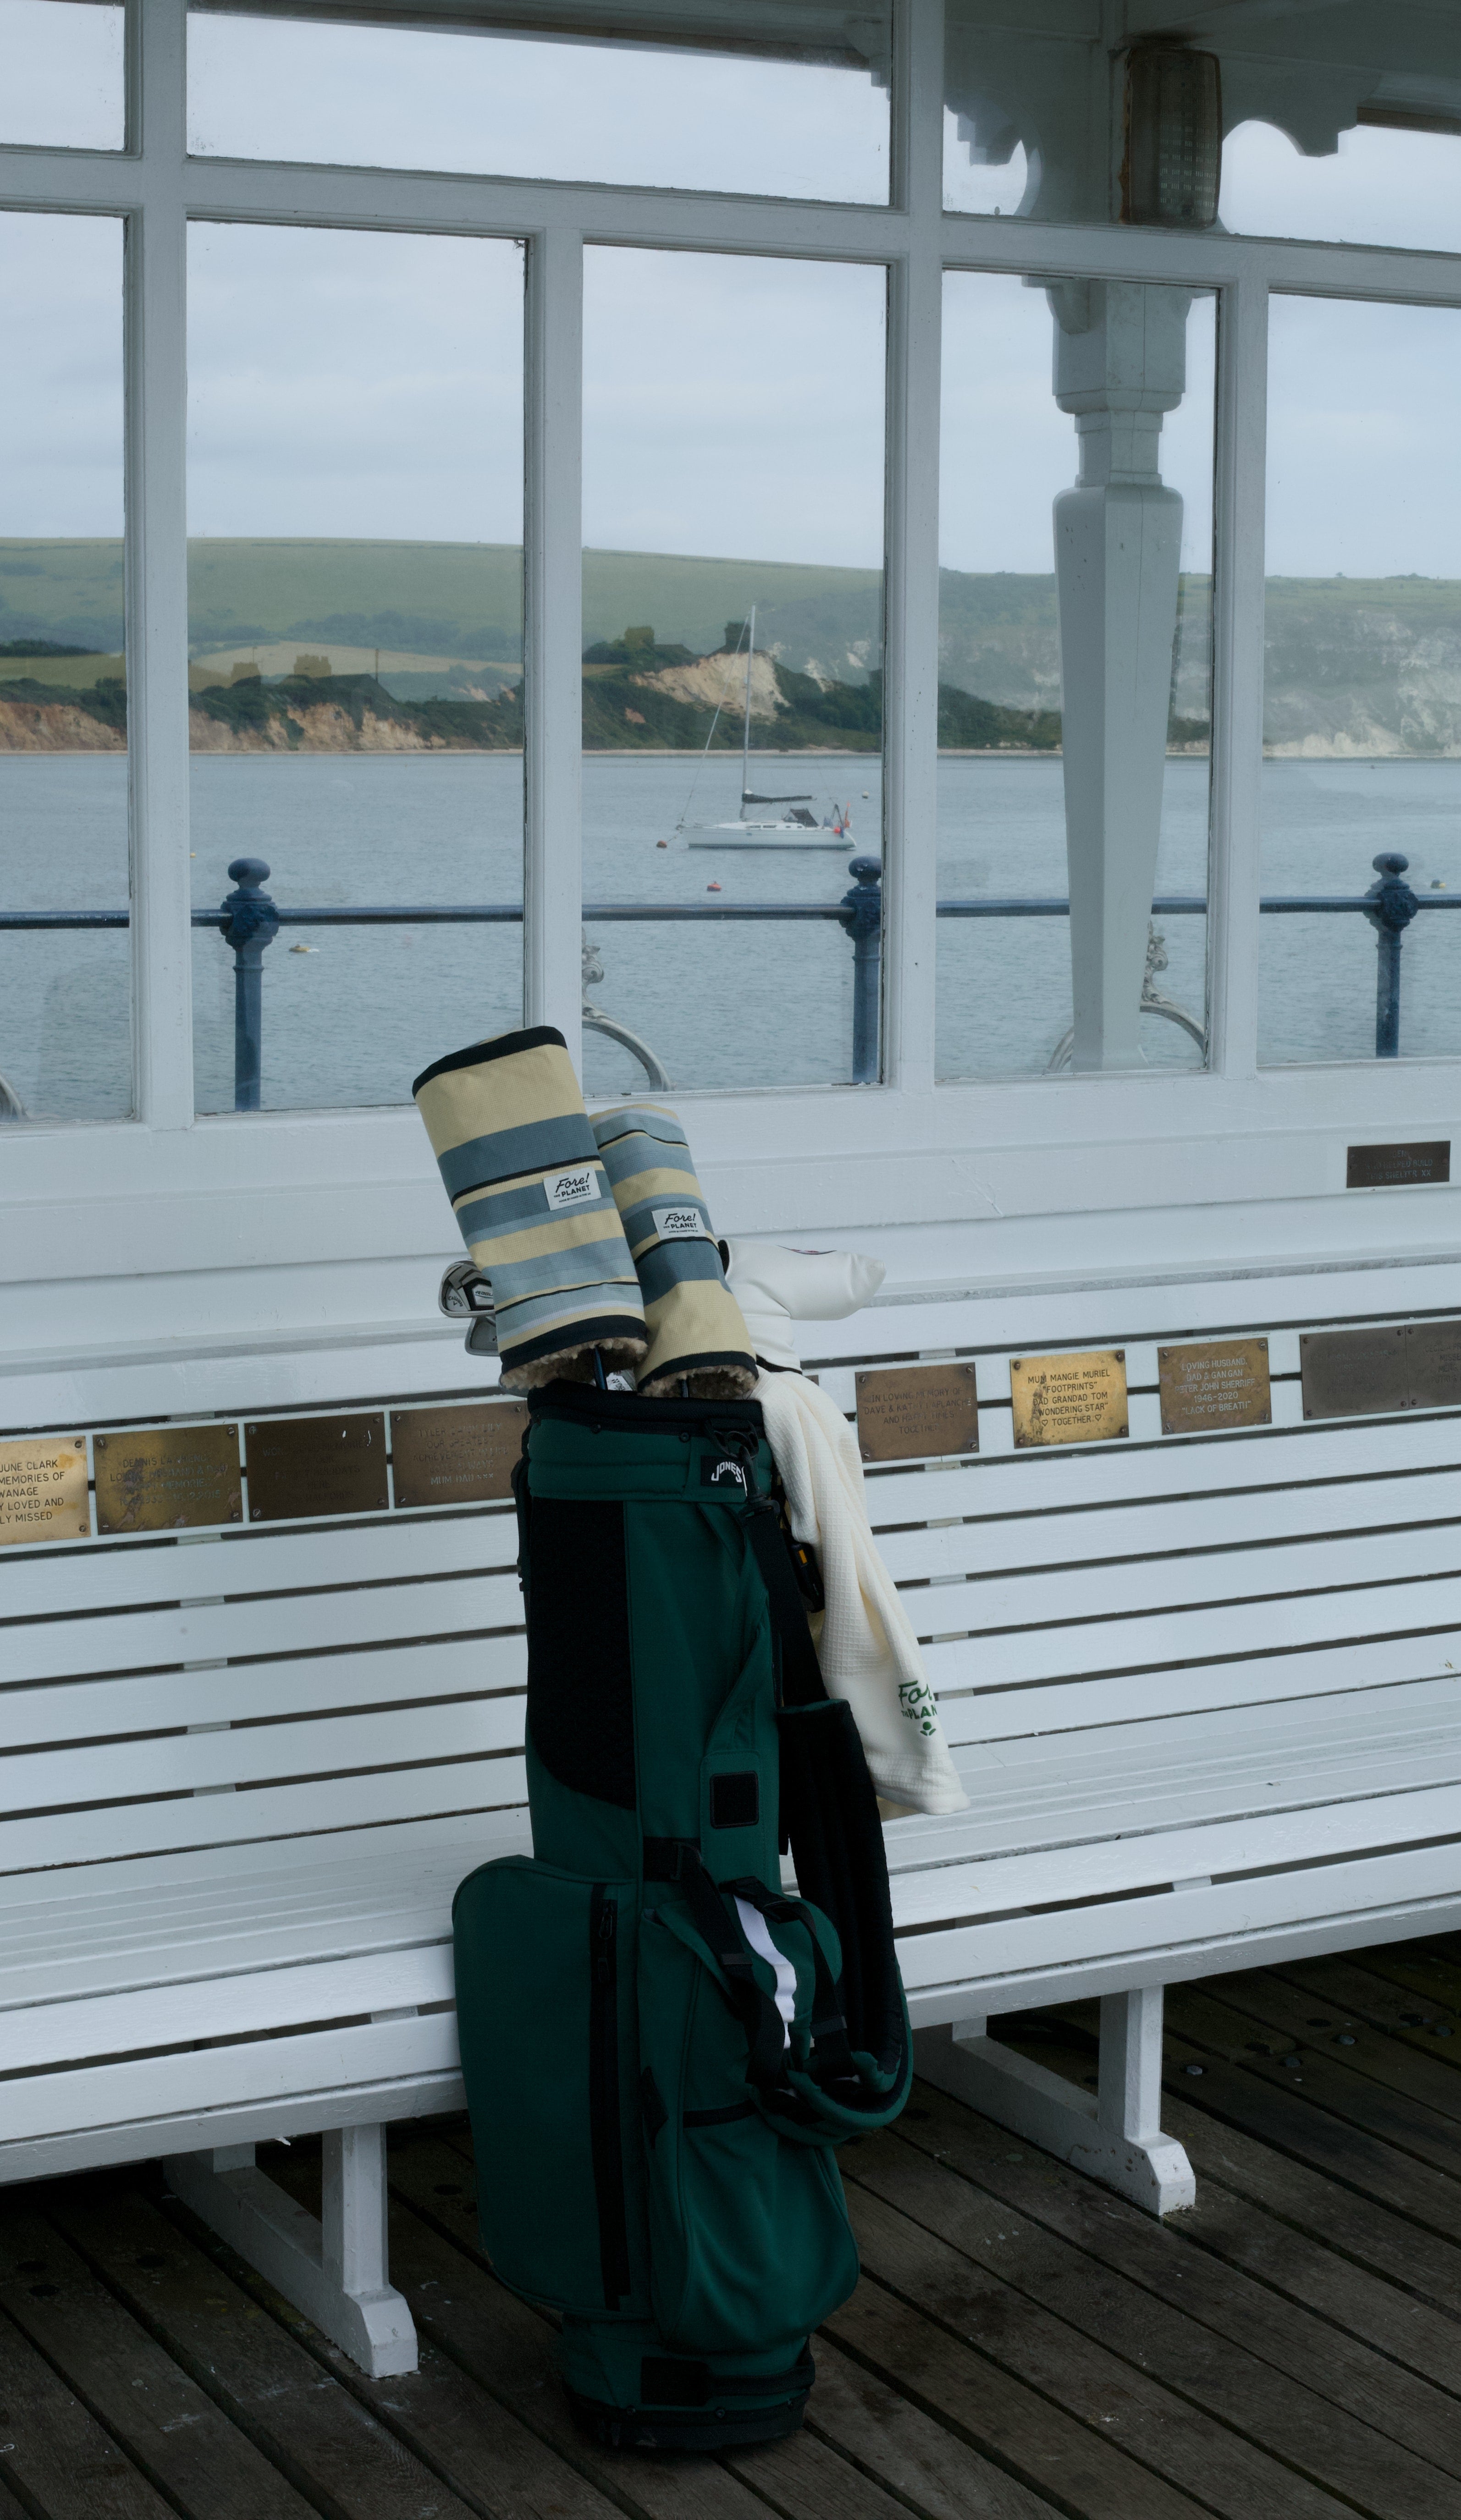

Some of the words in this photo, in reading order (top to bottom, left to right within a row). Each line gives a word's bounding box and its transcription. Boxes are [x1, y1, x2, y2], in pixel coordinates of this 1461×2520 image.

[1413, 1159, 1433, 1167] BUILD
[1385, 1170, 1417, 1179] SHELTER
[555, 1172, 590, 1193] Fore!
[561, 1185, 590, 1197] PLANET
[665, 1213, 696, 1225] Fore!
[1181, 1361, 1210, 1371] LOVING
[1028, 1375, 1047, 1384] MUM
[1050, 1372, 1080, 1382] MANGIE
[1083, 1369, 1110, 1379] MURIEL
[1186, 1373, 1202, 1381] DAD
[1204, 1372, 1209, 1380] &
[1211, 1370, 1227, 1379] GAN
[1228, 1369, 1243, 1378] GAN
[1043, 1381, 1097, 1393] "FOOTPRINTS"
[1175, 1384, 1198, 1394] PETER
[1200, 1382, 1219, 1391] JOHN
[1221, 1378, 1255, 1389] SHERRIFF
[883, 1392, 914, 1401] LOVING
[916, 1389, 949, 1399] MEMORY
[1033, 1397, 1048, 1406] DAD
[1052, 1394, 1088, 1404] GRANDAD
[1091, 1391, 1108, 1401] TOM
[1194, 1391, 1238, 1403] 1946-2020
[864, 1405, 886, 1415] DAVE
[888, 1404, 894, 1412] &
[1085, 1402, 1108, 1412] STAR"
[1181, 1405, 1205, 1415] "LACK
[883, 1415, 900, 1424] AND
[902, 1412, 926, 1423] HAPPY
[932, 1410, 954, 1419] TIMES
[1052, 1415, 1091, 1426] TOGETHER
[419, 1428, 446, 1437] TYLER
[899, 1423, 939, 1434] TOGETHER
[427, 1439, 444, 1449] OUR
[27, 1459, 58, 1471] CLARK
[53, 1471, 65, 1481] OF
[711, 1461, 742, 1483] JONES
[430, 1475, 452, 1485] MUM
[456, 1474, 474, 1483] DAD
[8, 1500, 40, 1511] LOVED
[44, 1497, 64, 1507] AND
[16, 1511, 53, 1522] MISSED
